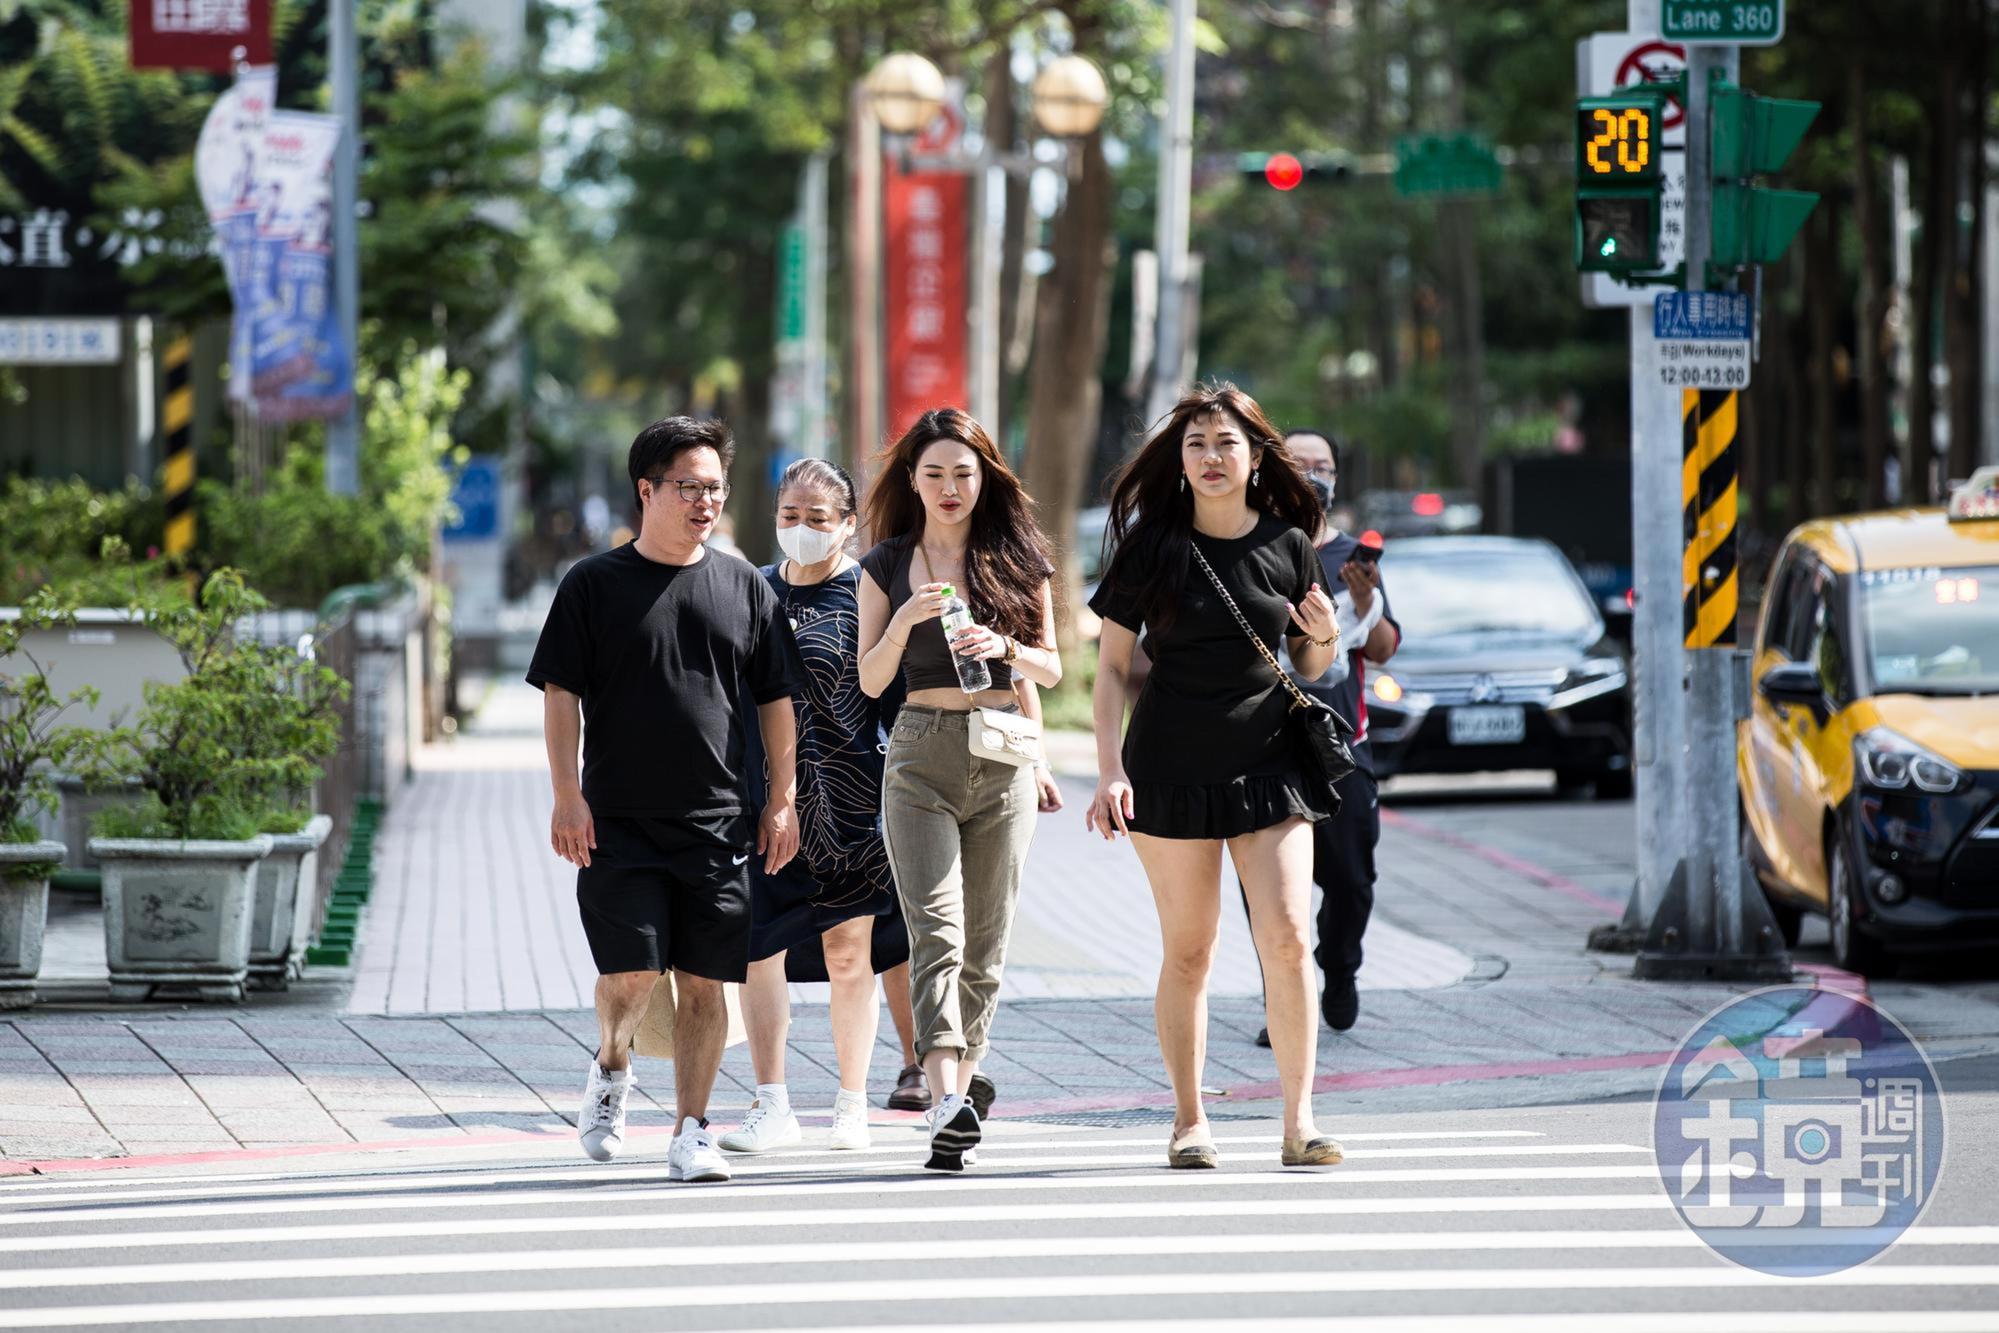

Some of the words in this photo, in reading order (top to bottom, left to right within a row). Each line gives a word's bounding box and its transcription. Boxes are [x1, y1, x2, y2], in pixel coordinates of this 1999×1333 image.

[1667, 5, 1721, 31] Lane
[1732, 5, 1773, 31] 360
[1587, 109, 1649, 173] 20
[1661, 366, 1745, 385] 12:00-13:00
